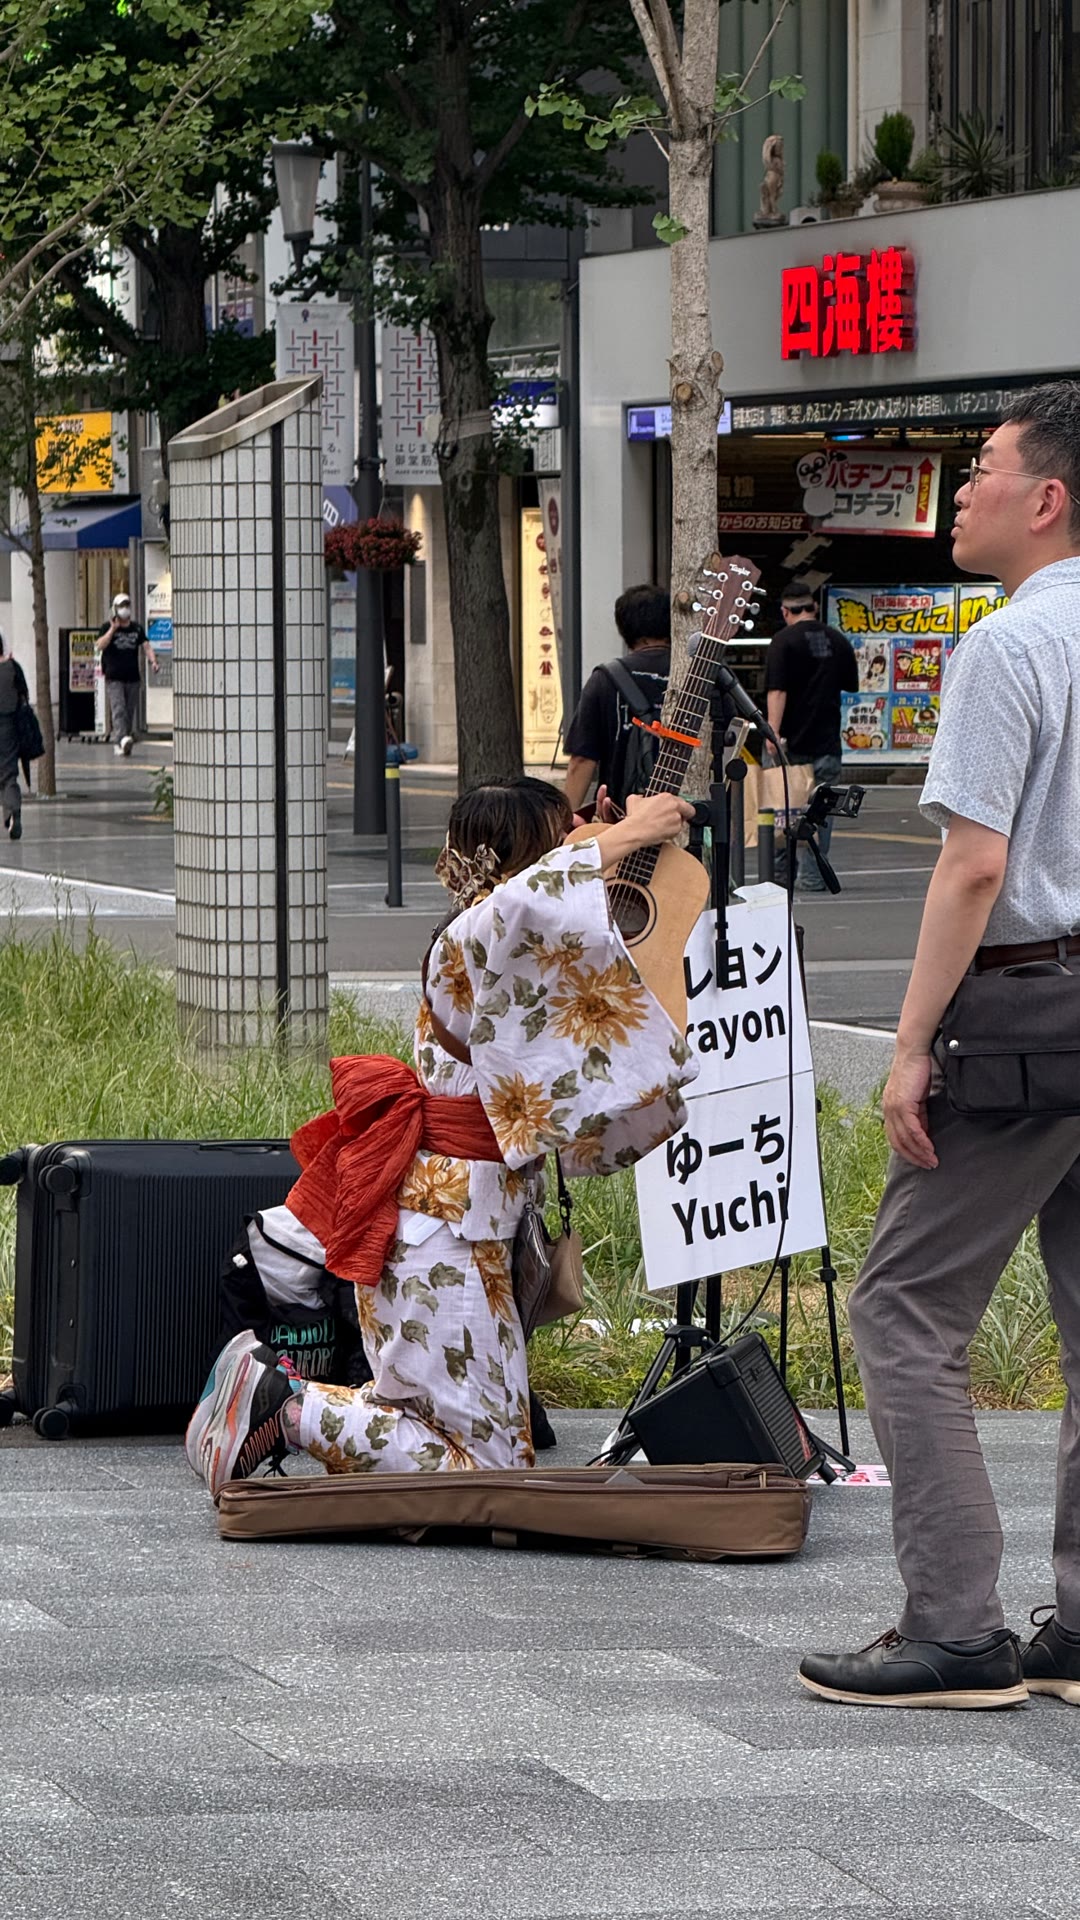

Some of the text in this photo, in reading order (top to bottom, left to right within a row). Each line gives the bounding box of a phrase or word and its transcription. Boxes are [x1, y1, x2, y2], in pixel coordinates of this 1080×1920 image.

[782, 246, 904, 360] 四海樓
[825, 461, 913, 490] パチンコ
[729, 563, 751, 577] Taylor
[666, 1114, 785, 1185] ゆーち
[671, 1171, 789, 1246] Yuchi
